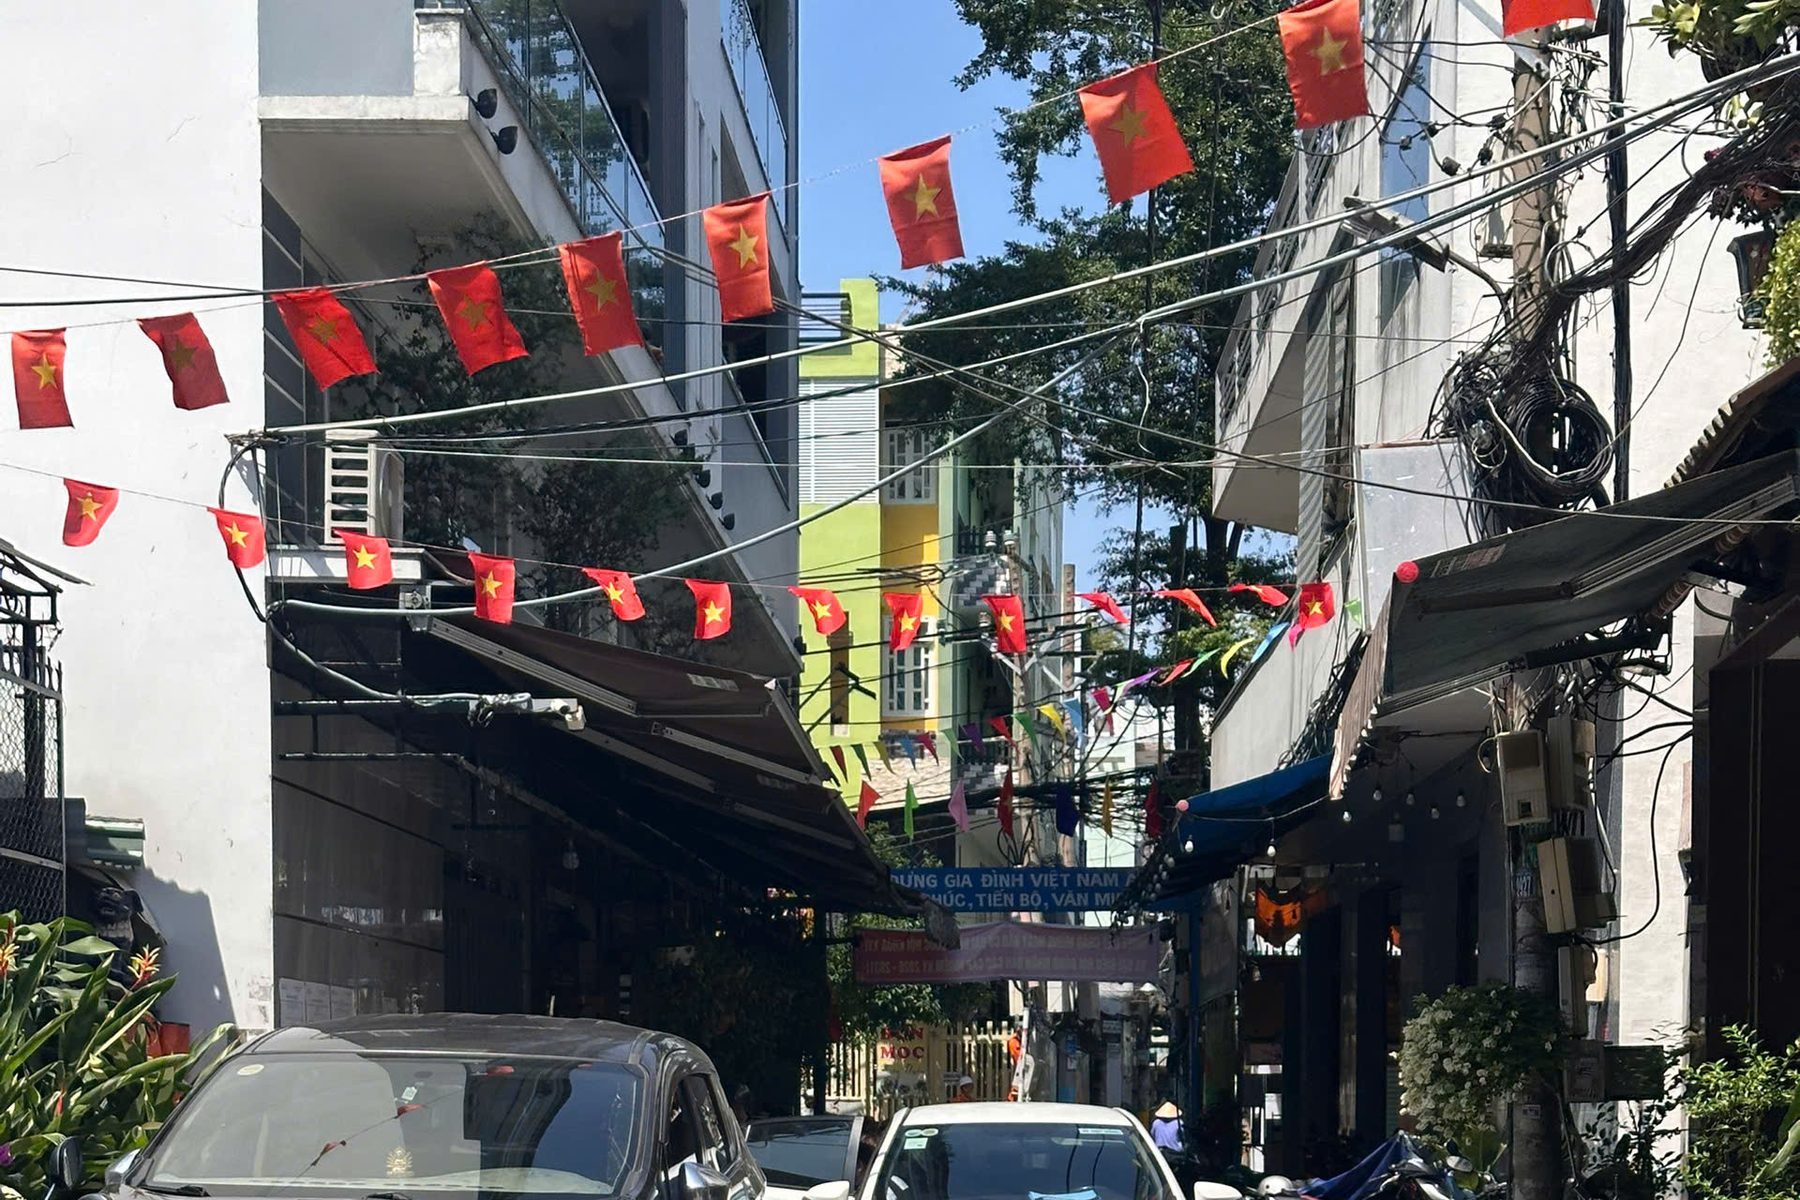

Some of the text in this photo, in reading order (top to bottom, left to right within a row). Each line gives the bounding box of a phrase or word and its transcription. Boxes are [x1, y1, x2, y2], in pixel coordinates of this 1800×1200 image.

[945, 873, 973, 888] GIA
[981, 869, 1024, 888] ĐÌNH
[1030, 869, 1070, 890] VIỆT
[1077, 873, 1119, 888] NAM
[975, 888, 1014, 907] TIẾN
[1051, 889, 1089, 907] VĂN
